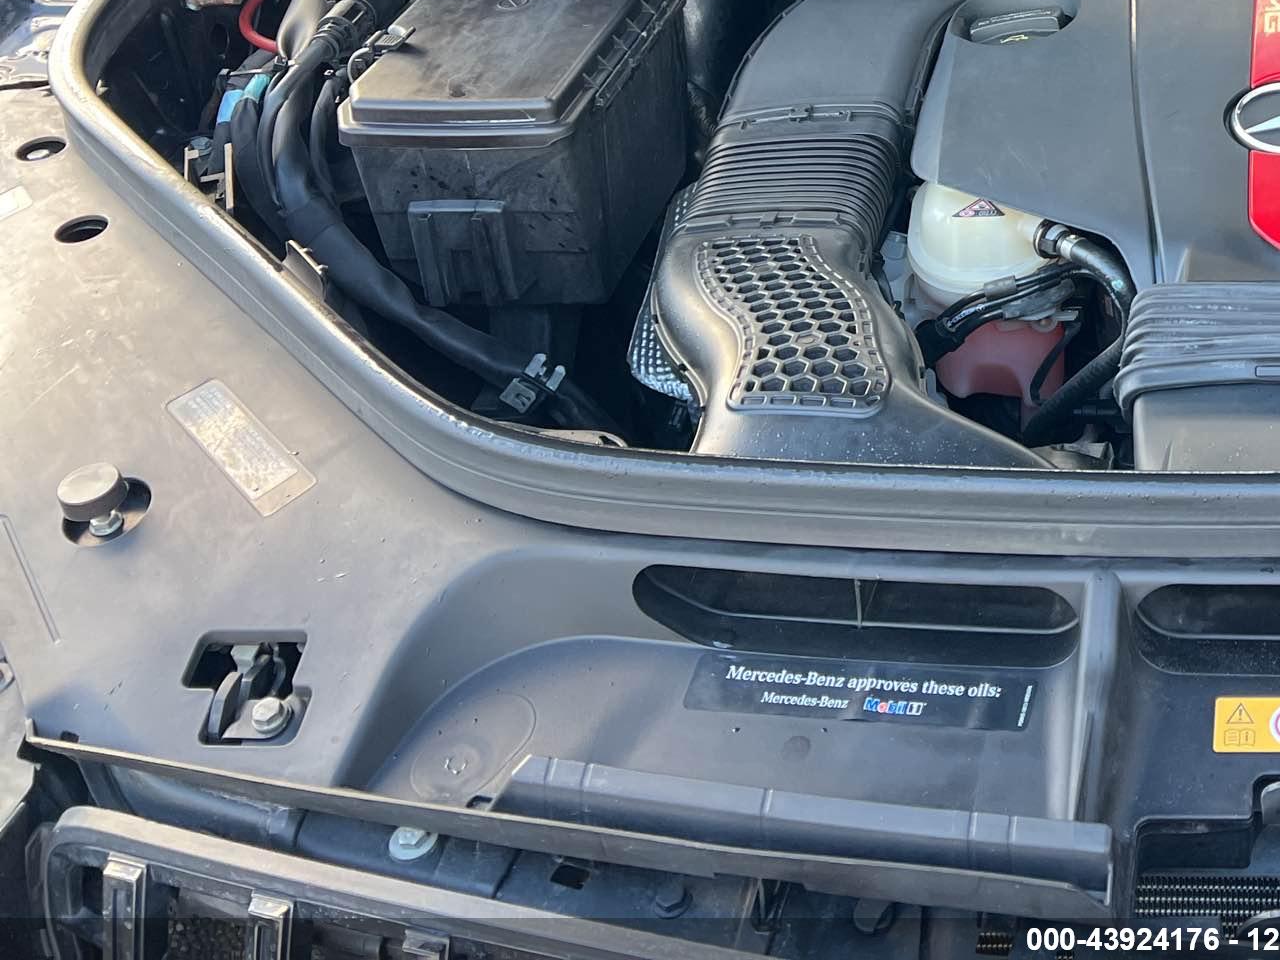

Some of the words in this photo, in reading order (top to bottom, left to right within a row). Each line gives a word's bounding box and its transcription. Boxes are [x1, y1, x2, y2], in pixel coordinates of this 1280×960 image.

[725, 665, 845, 688] Mercedes-Benz
[847, 677, 918, 697] approves
[921, 681, 965, 696] these
[967, 683, 1002, 699] oils:
[760, 691, 849, 709] Mercedes-Benz
[863, 696, 907, 715] Mobil
